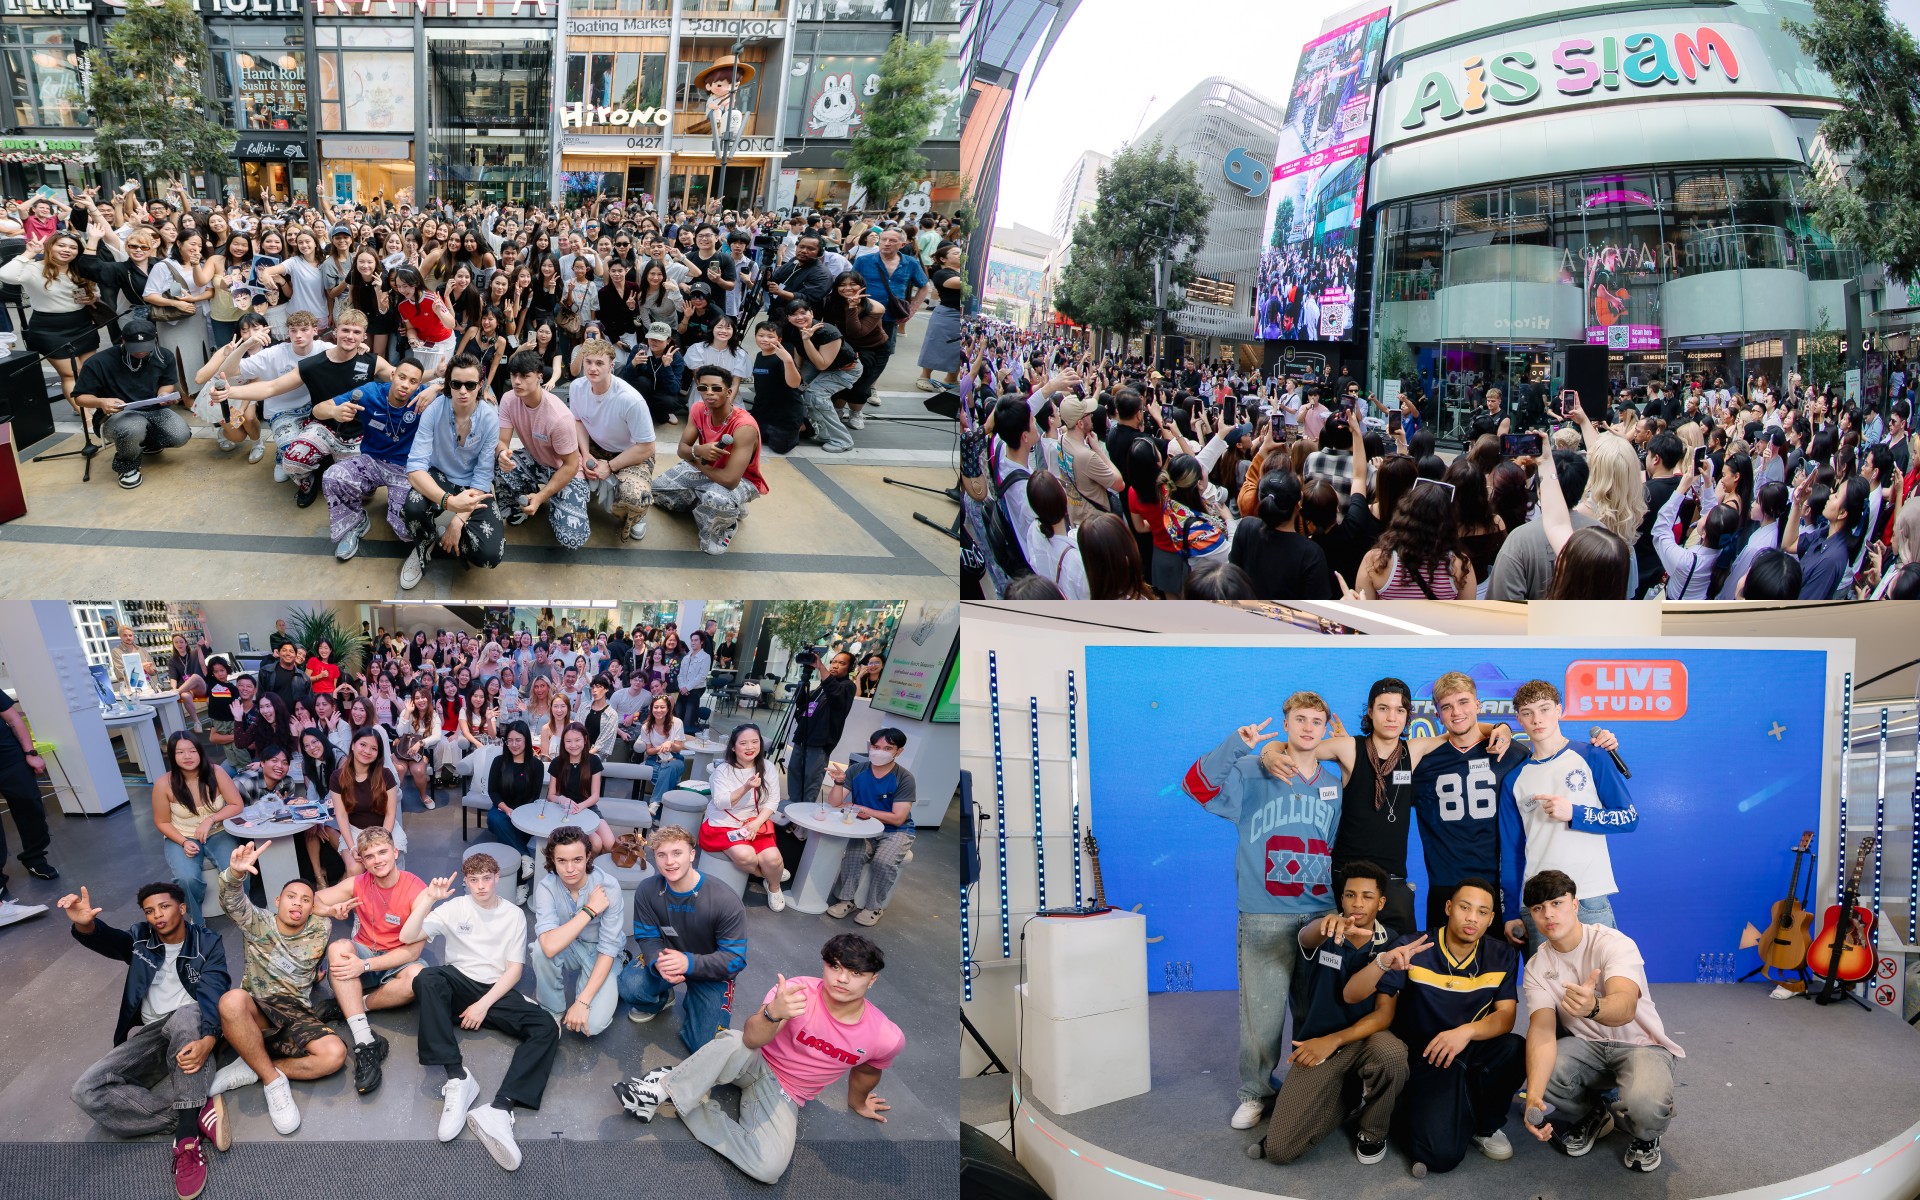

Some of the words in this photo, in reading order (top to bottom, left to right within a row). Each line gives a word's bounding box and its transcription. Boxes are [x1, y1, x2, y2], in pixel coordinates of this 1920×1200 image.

[624, 18, 671, 31] Market
[241, 66, 276, 80] Hand
[280, 66, 305, 80] Roll
[241, 82, 268, 91] Sushi
[270, 82, 278, 91] &
[280, 82, 306, 91] More
[1, 139, 37, 150] JUICY
[47, 140, 82, 150] BABY
[627, 137, 663, 149] 0427
[1596, 667, 1672, 690] LIVE
[1579, 696, 1672, 711] STUDIO
[1436, 772, 1497, 822] 86
[796, 1030, 861, 1066] LACOSTE
